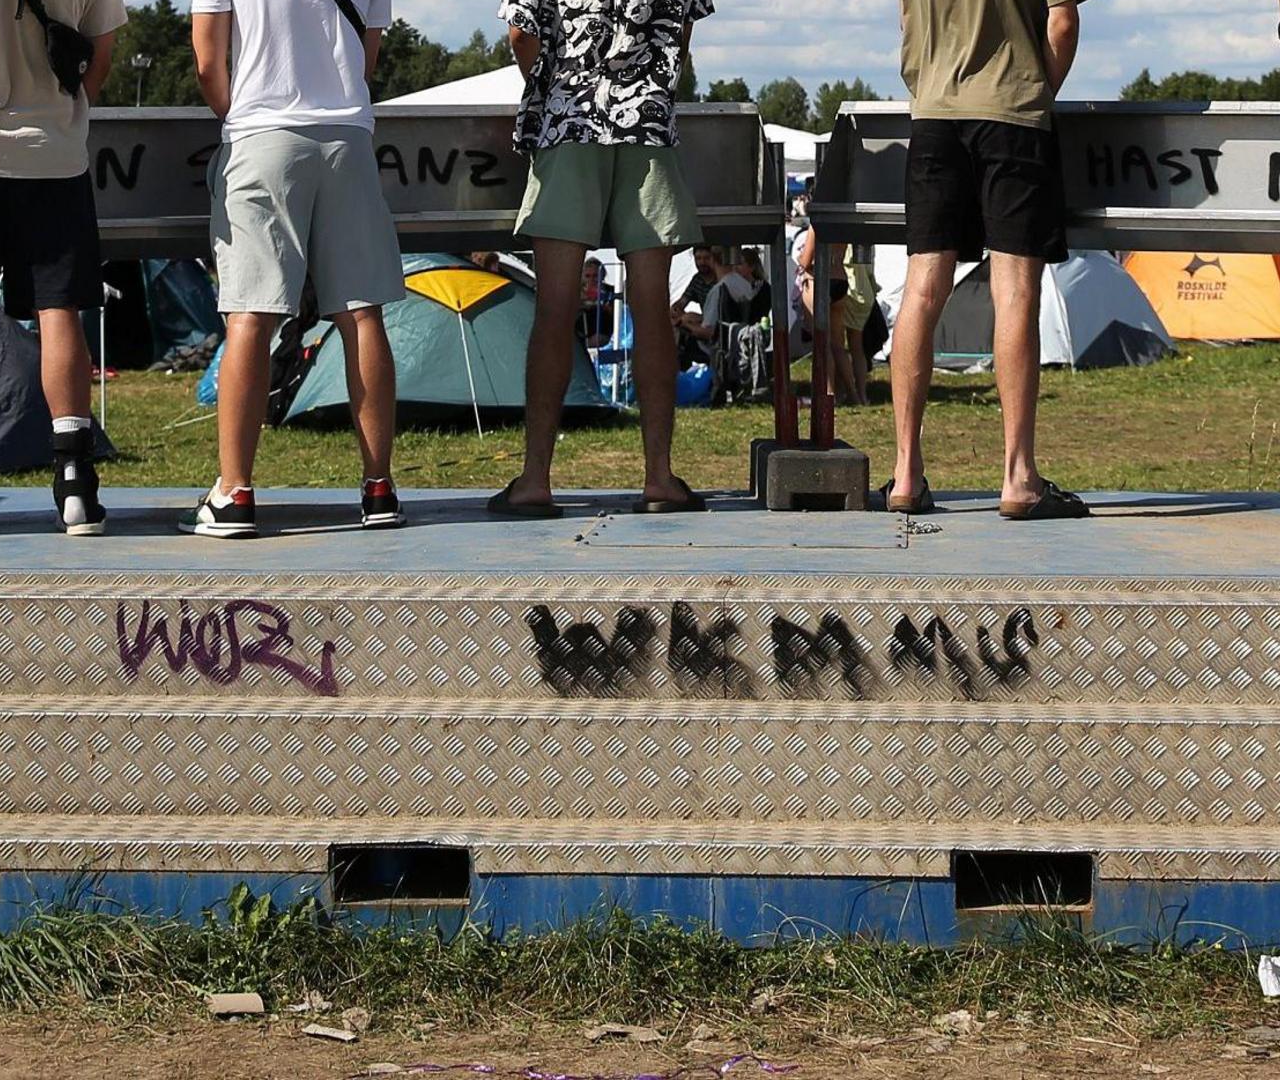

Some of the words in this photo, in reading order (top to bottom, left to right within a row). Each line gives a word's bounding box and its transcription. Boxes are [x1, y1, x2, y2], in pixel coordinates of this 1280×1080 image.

[1086, 142, 1223, 196] HAST
[1176, 281, 1227, 291] ROSKILDE
[1177, 291, 1225, 301] FESTIVAL
